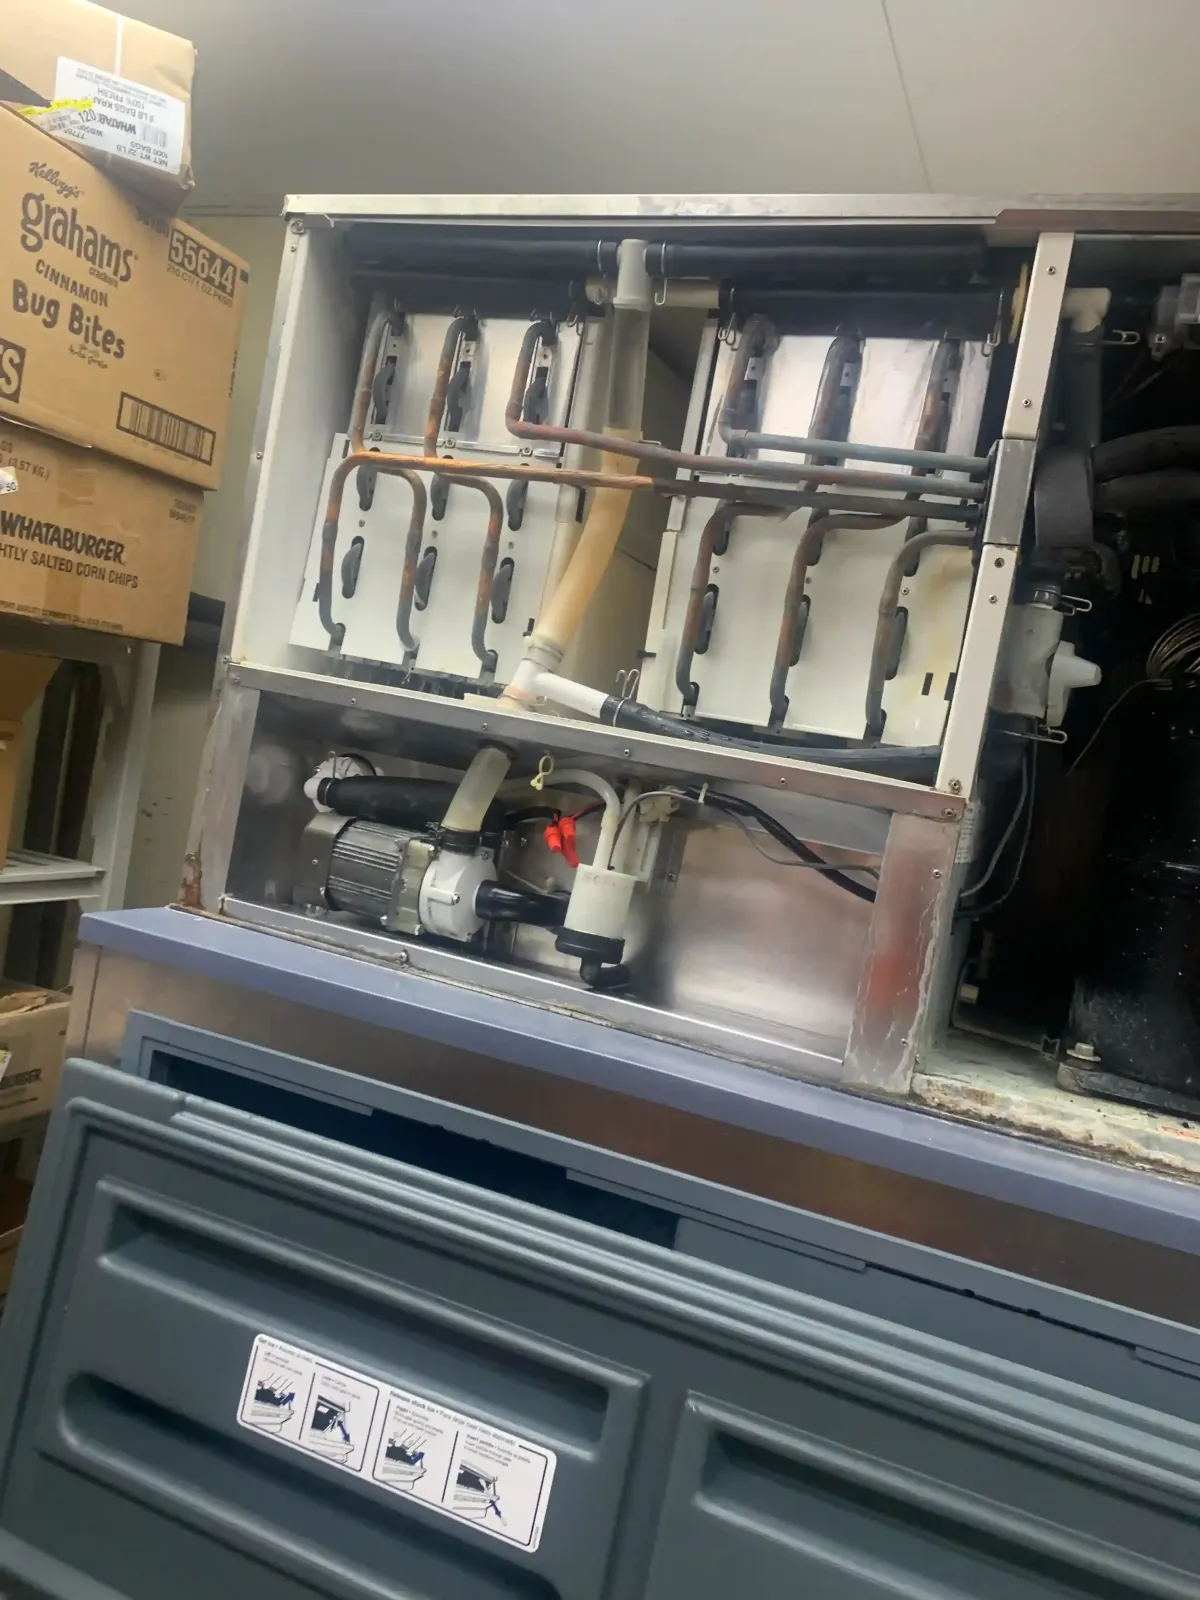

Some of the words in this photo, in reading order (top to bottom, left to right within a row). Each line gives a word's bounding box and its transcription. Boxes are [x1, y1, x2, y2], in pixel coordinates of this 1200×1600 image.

[97, 87, 124, 103] FRESH
[78, 109, 97, 123] 120
[116, 144, 127, 153] LB
[130, 141, 152, 154] BAGS
[153, 157, 168, 167] NET
[28, 161, 81, 199] Kellogg's
[20, 192, 133, 282] grahams
[170, 230, 235, 294] 55644
[35, 259, 108, 308] CINNAMON
[12, 278, 60, 329] Bug
[68, 302, 125, 359] Bites
[0, 510, 125, 566] WHATABURGER
[31, 550, 73, 573] SALTED
[76, 562, 106, 581] CORN
[108, 570, 139, 589] CHIPS
